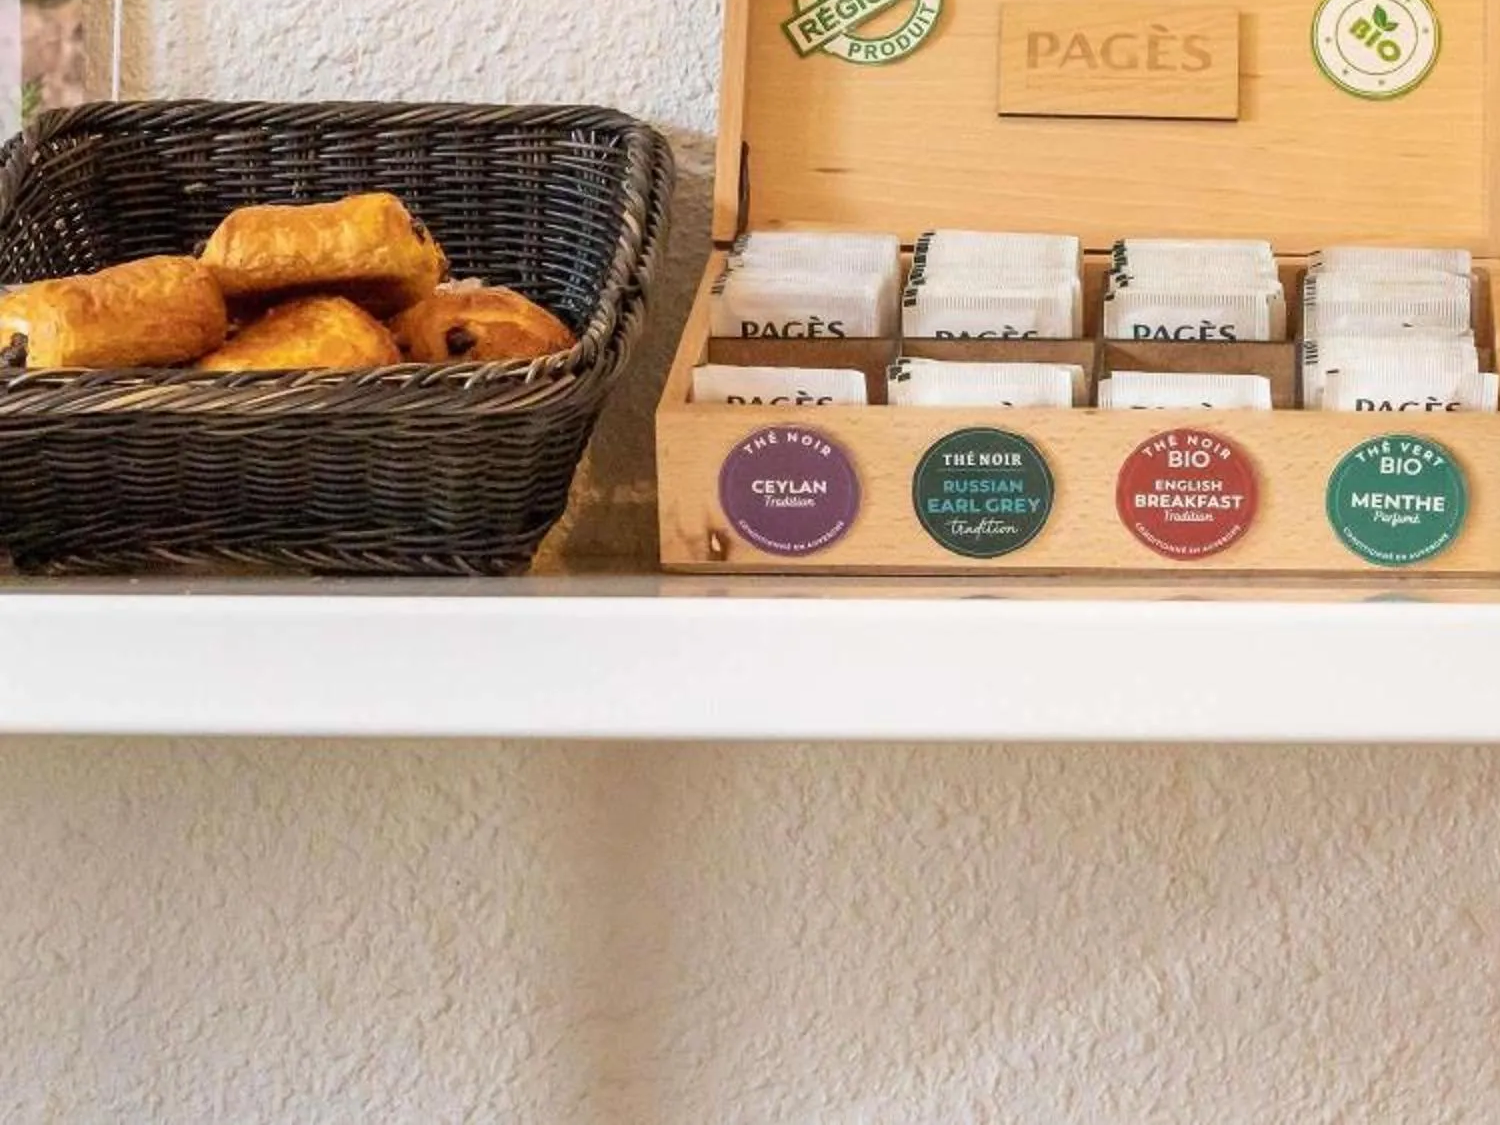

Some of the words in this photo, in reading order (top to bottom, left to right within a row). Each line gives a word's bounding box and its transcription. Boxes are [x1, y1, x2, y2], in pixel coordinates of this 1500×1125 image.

[847, 12, 936, 60] PRODUIT
[1348, 16, 1401, 63] BIO
[1026, 23, 1213, 73] PAGÈS
[743, 431, 778, 455] THÉ
[787, 431, 832, 457] NOIR
[1187, 434, 1232, 460] NOIR
[1355, 440, 1391, 463] THÉ
[1400, 442, 1447, 468] VERT
[942, 450, 977, 466] THÉ
[979, 453, 1023, 467] NOIR
[1168, 450, 1211, 468] BIO
[1379, 456, 1423, 476] BIO
[751, 480, 827, 494] CEYLAN
[943, 479, 1024, 494] RUSSIAN
[1155, 479, 1223, 492] ENGLISH
[927, 498, 981, 514] EARL
[985, 498, 1041, 514] GREY
[1135, 494, 1244, 509] BREAKFAST
[1351, 492, 1446, 513] MENTHE
